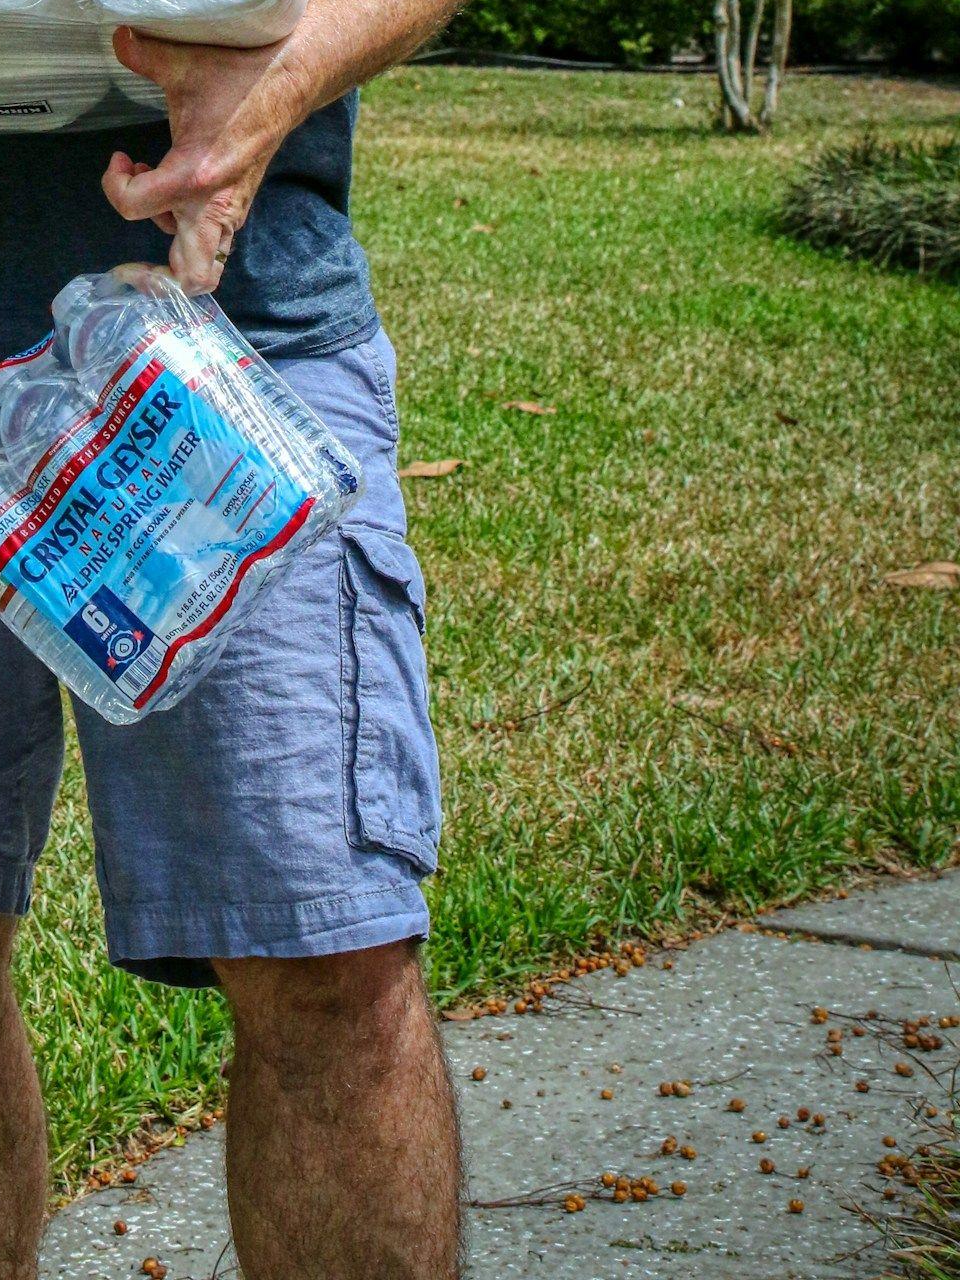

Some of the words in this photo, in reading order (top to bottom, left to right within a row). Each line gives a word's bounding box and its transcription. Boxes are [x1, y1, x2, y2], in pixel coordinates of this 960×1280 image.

[19, 489, 106, 583] CRYSTAL
[96, 390, 183, 491] GEYSER
[20, 488, 61, 537] BOTTLED
[62, 467, 75, 484] AT
[78, 442, 101, 464] THE
[102, 393, 137, 440] SOURCE
[61, 536, 114, 607] ALPINE
[106, 484, 162, 549] SPRING
[155, 429, 201, 490] WATER
[79, 458, 162, 557] NATURAL
[125, 548, 135, 560] BY
[133, 537, 144, 550] CG
[143, 506, 172, 538] ROXANE
[141, 544, 154, 561] FAMILY
[154, 530, 169, 546] OWNED
[168, 520, 177, 530] AND
[187, 609, 203, 624] 101.5
[200, 601, 209, 611] FL
[206, 590, 217, 602] OZ
[215, 577, 230, 593] (3.17
[191, 590, 201, 601] FL
[199, 579, 210, 592] OZ
[81, 604, 110, 634] 6
